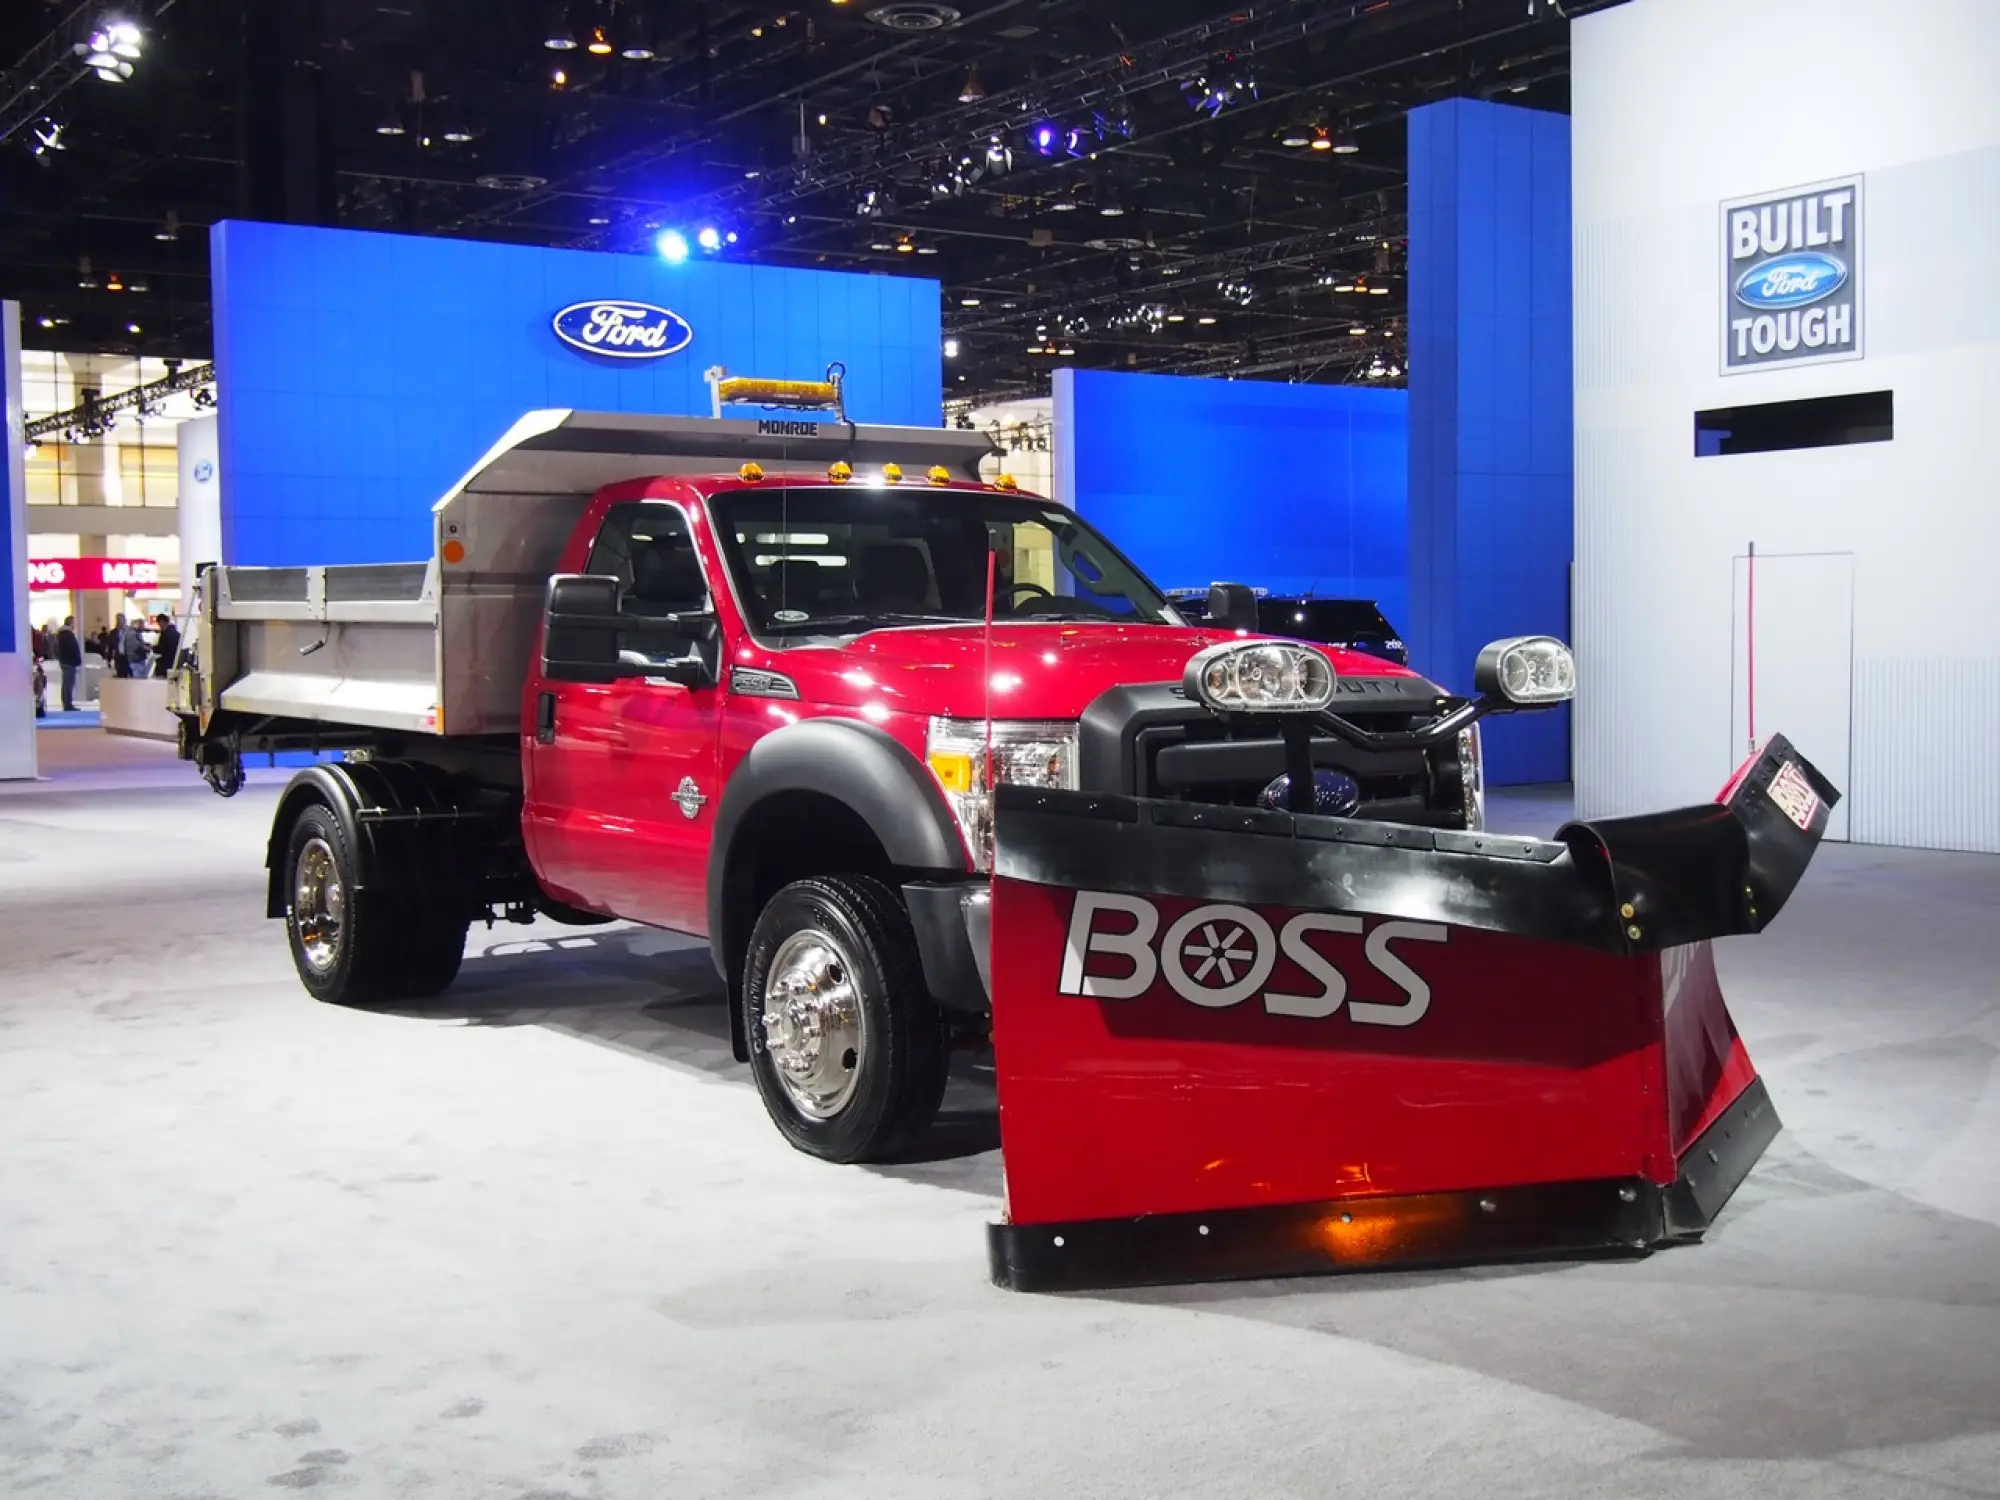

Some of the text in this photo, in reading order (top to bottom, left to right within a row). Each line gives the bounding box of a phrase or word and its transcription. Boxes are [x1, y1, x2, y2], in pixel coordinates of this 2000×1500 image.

[1732, 191, 1851, 259] BUILT
[1762, 265, 1821, 297] Ford
[582, 305, 668, 348] Ford
[1732, 304, 1851, 357] TOUGH
[758, 419, 818, 437] MONROE
[1336, 680, 1403, 694] UTY
[1059, 890, 1447, 1026] BOSS
